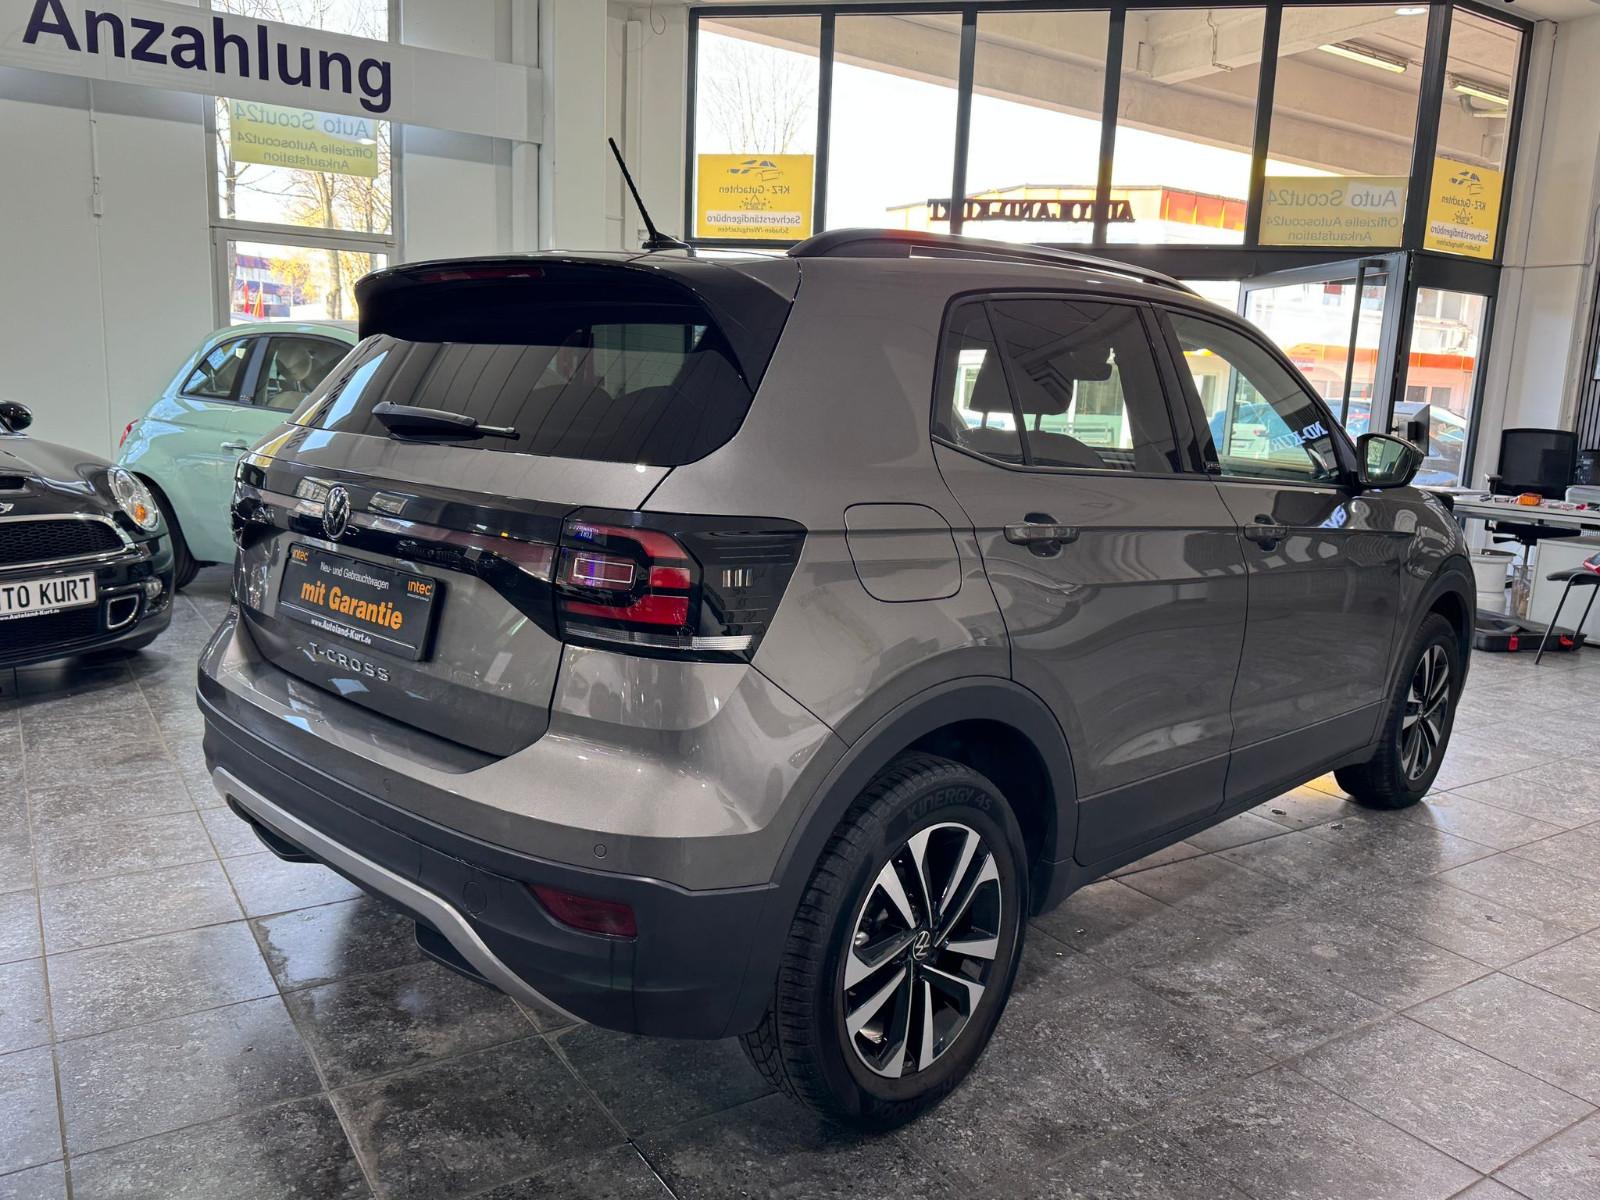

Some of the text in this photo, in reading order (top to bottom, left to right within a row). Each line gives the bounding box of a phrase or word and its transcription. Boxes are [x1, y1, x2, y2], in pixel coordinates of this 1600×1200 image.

[22, 0, 391, 113] Anzahlung
[0, 577, 90, 610] TO KURT
[320, 561, 332, 574] Neu-
[332, 565, 342, 577] und
[343, 568, 390, 590] Gebrauchtwagen
[407, 580, 433, 596] intec
[300, 579, 403, 630] mit Garantie
[309, 641, 391, 682] T-CROSS
